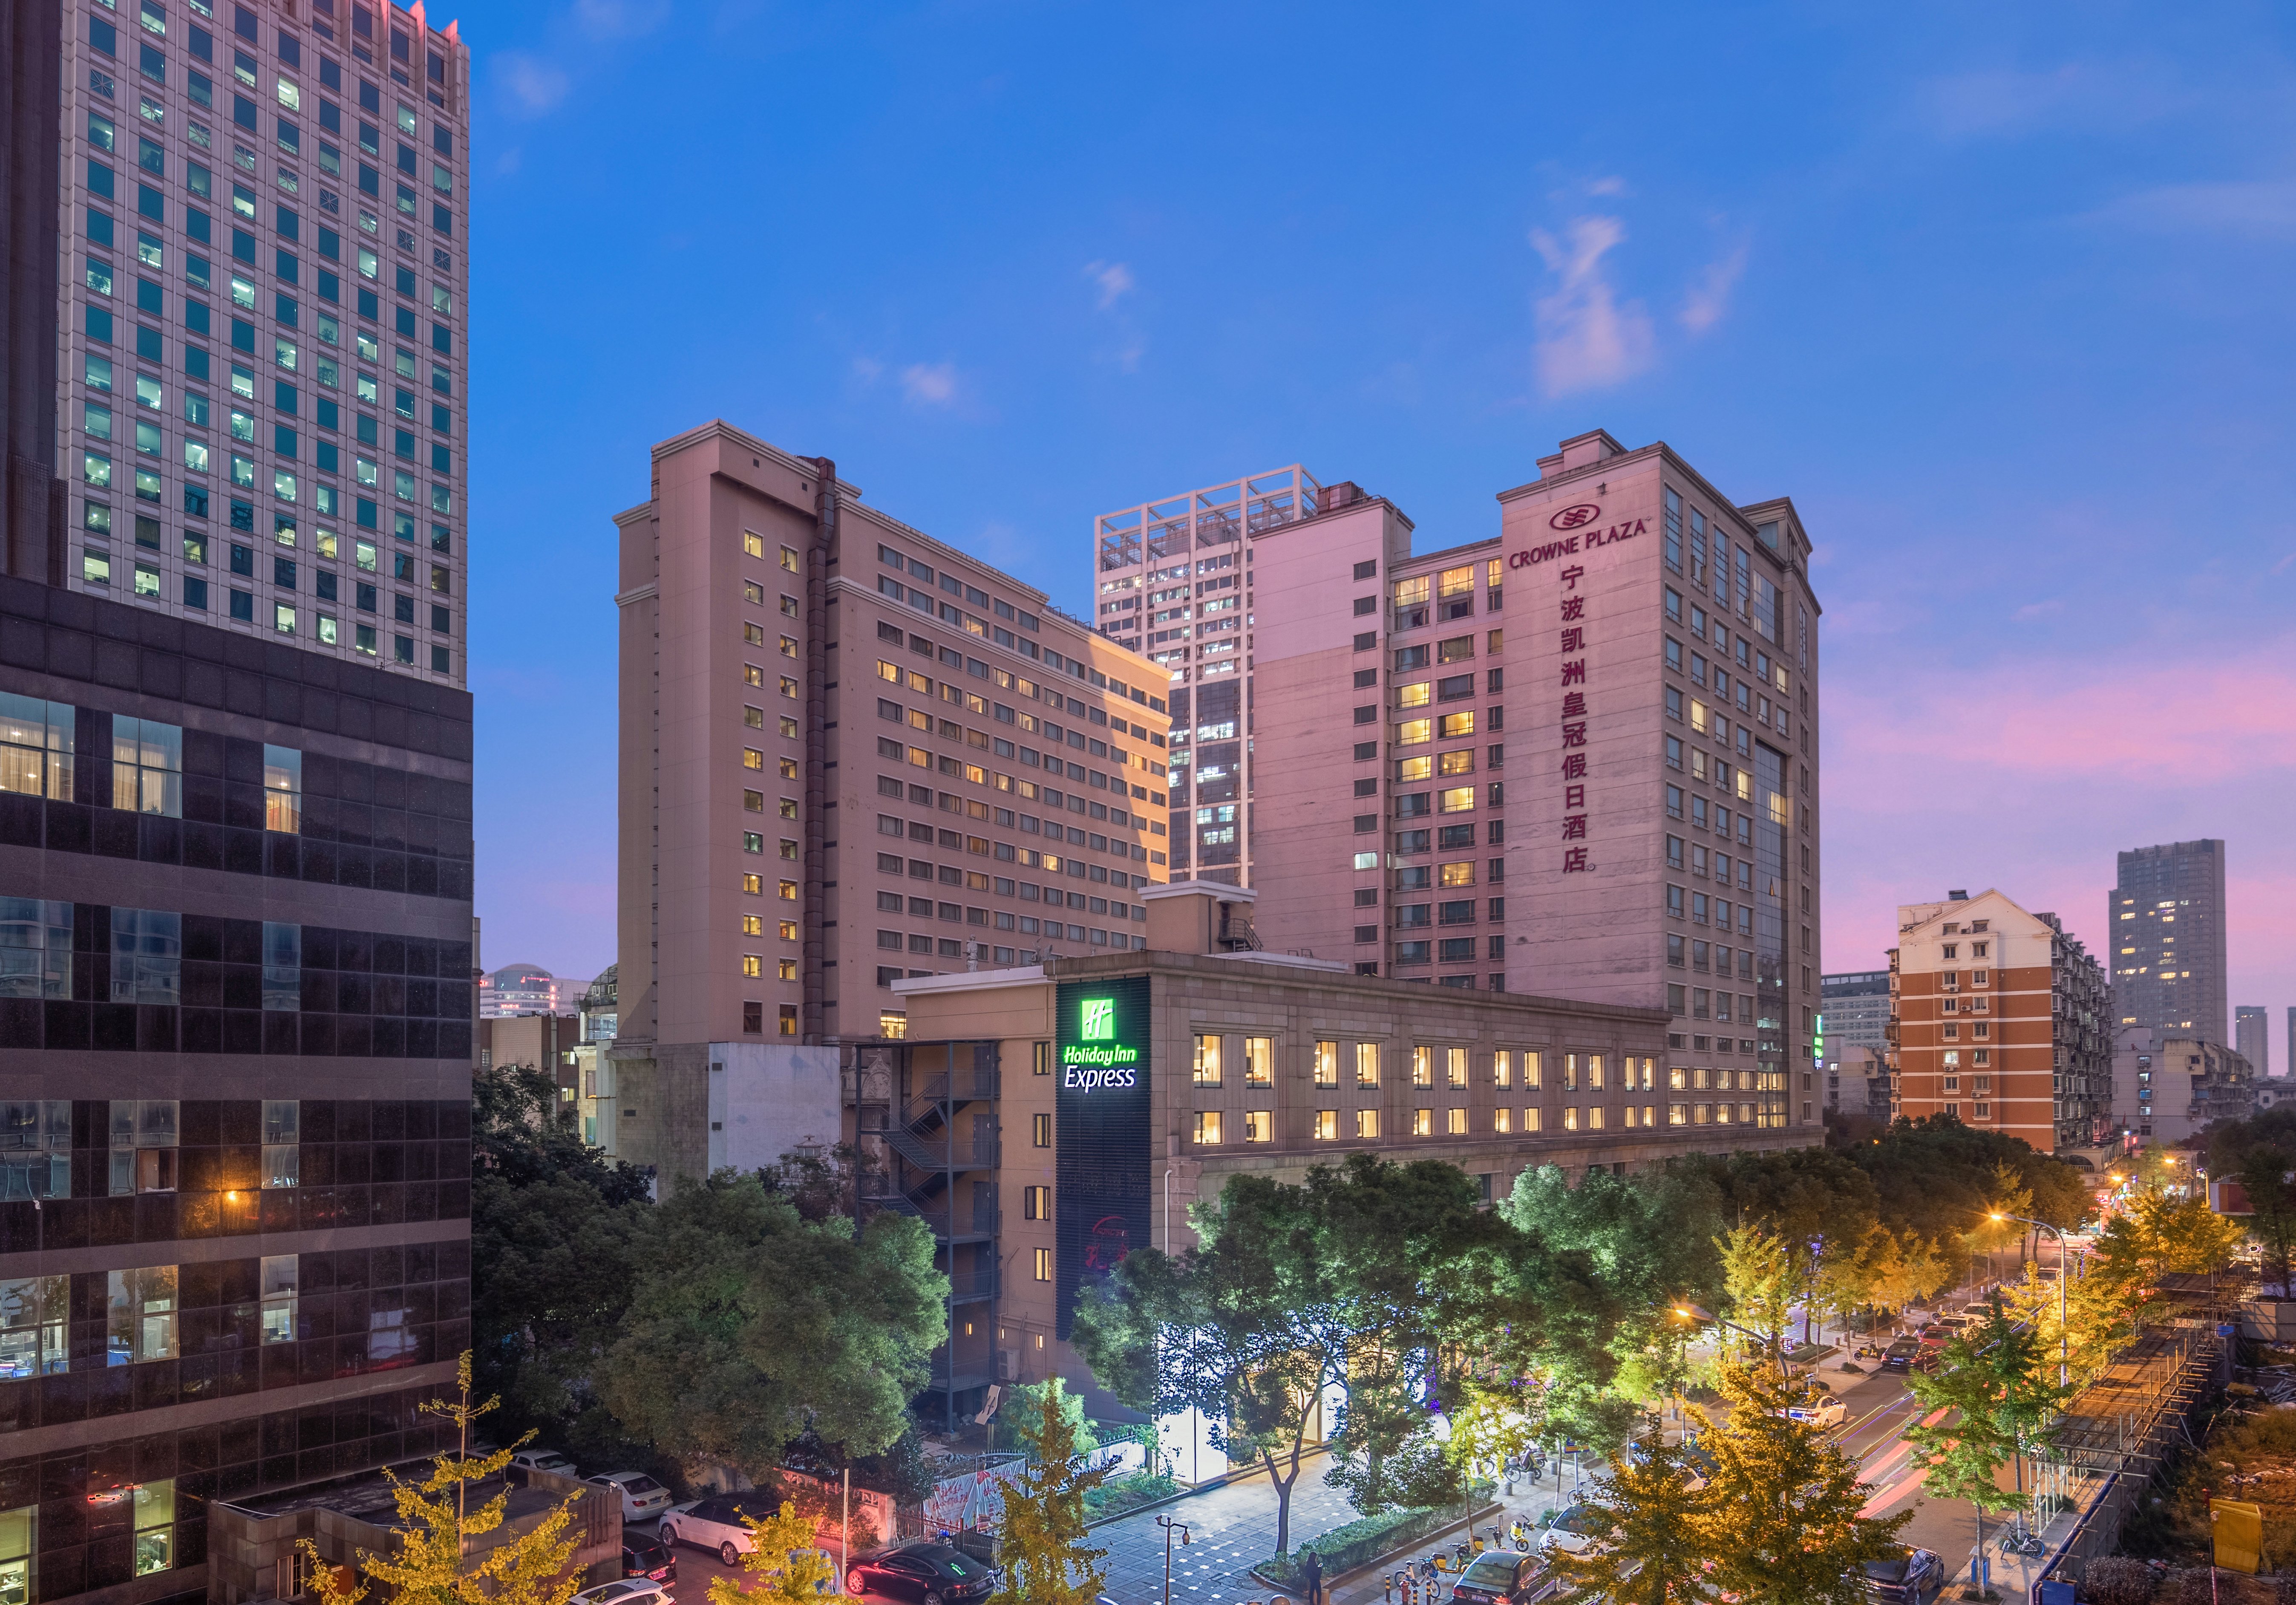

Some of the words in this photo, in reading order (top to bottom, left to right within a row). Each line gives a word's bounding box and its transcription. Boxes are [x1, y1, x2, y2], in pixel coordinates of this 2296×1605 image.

[1509, 536, 1579, 569] CROWNE
[1586, 518, 1647, 549] PLAZA
[1561, 564, 1587, 873] 宁波凯洲皇冠假日酒店
[1064, 1046, 1113, 1065] Holiday
[1114, 1044, 1136, 1062] Inn
[1064, 1065, 1136, 1093] Express
